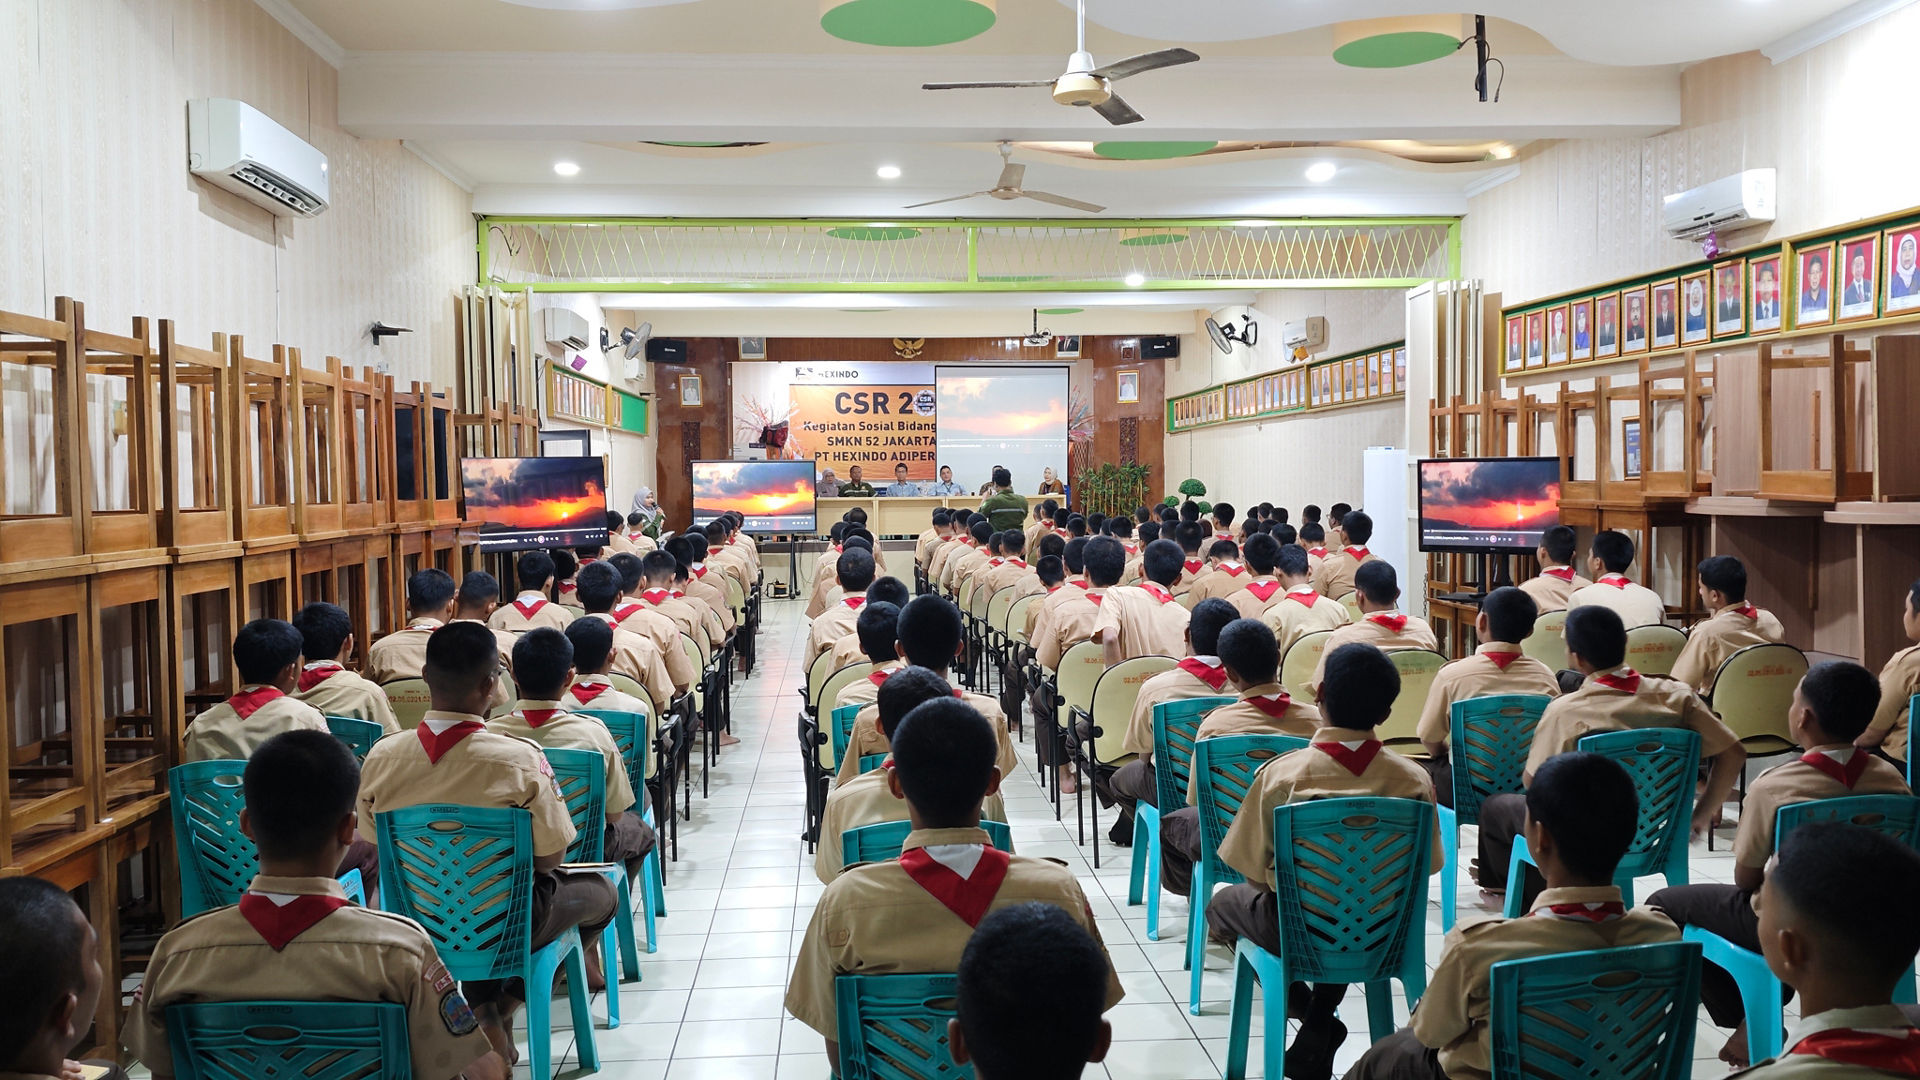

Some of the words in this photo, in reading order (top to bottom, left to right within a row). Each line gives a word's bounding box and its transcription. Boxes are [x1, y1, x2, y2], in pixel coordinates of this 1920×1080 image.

[835, 392, 890, 414] CSR
[803, 421, 855, 433] Kegiatan
[858, 420, 894, 431] Sosial
[897, 421, 936, 433] Bidang
[827, 436, 862, 446] SMKN
[865, 436, 879, 446] 52
[882, 436, 936, 446] JAKARTA
[814, 452, 829, 461] PT
[833, 452, 887, 461] HEXINDO
[890, 452, 935, 461] ADIPER
